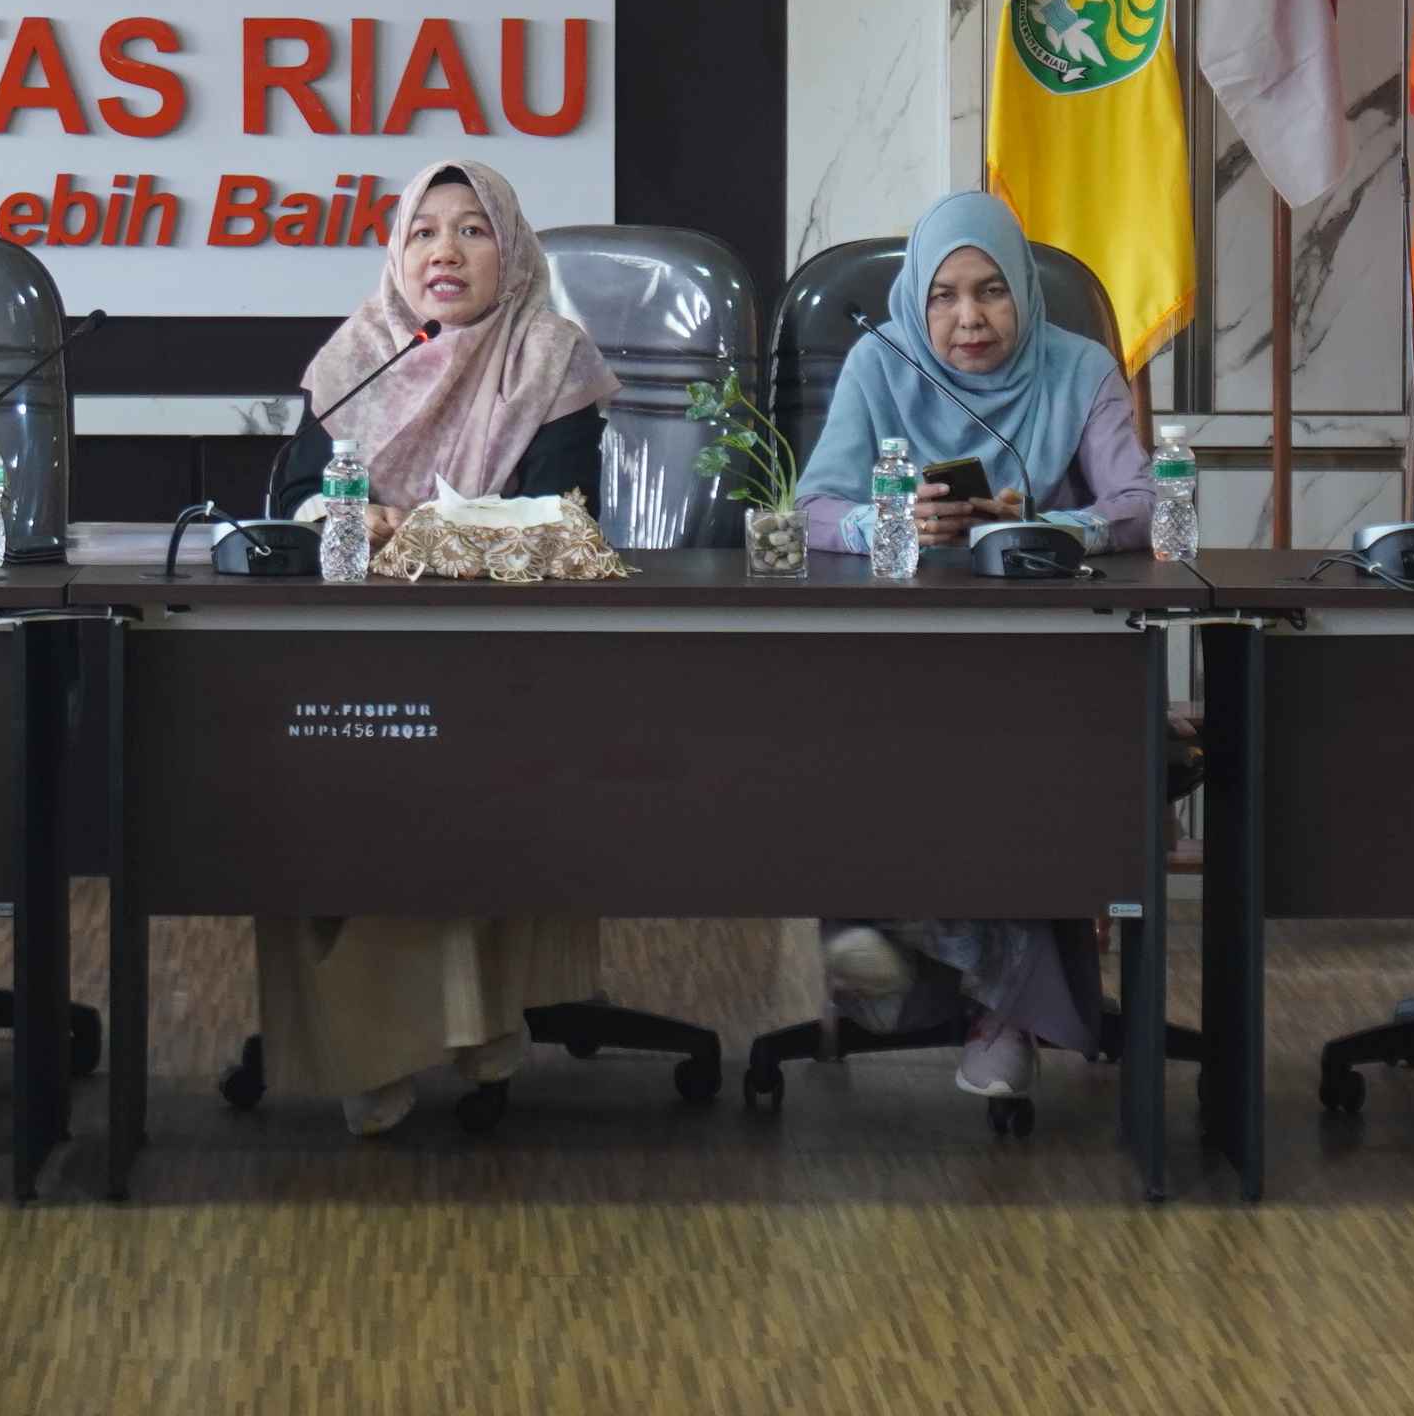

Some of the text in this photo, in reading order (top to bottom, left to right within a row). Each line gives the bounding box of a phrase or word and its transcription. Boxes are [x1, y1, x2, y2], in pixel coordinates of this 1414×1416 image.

[242, 17, 589, 138] RIAU
[1043, 54, 1066, 71] RIAU
[207, 174, 402, 246] Baik
[404, 703, 431, 716] UR
